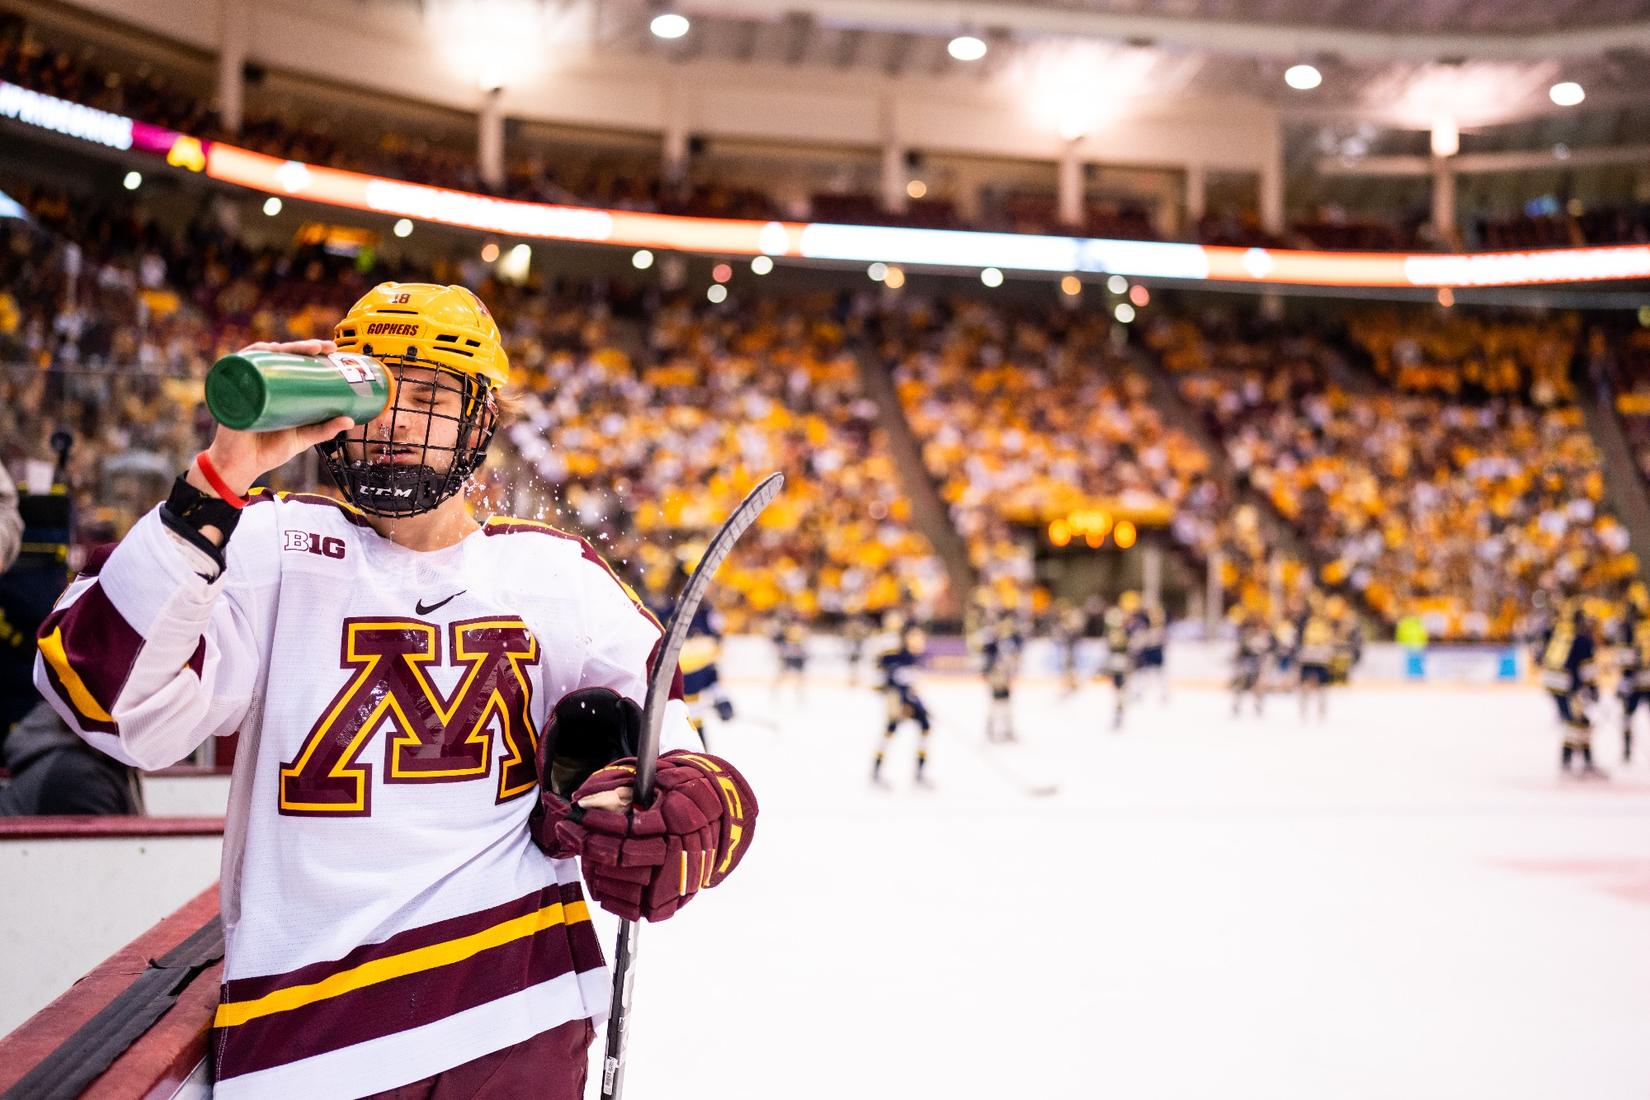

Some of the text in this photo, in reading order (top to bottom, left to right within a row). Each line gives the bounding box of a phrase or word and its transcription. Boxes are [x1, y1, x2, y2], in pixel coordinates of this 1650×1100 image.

[392, 293, 411, 304] 18
[367, 323, 419, 336] GOPHERS
[360, 484, 413, 498] CCM
[278, 615, 541, 817] M
